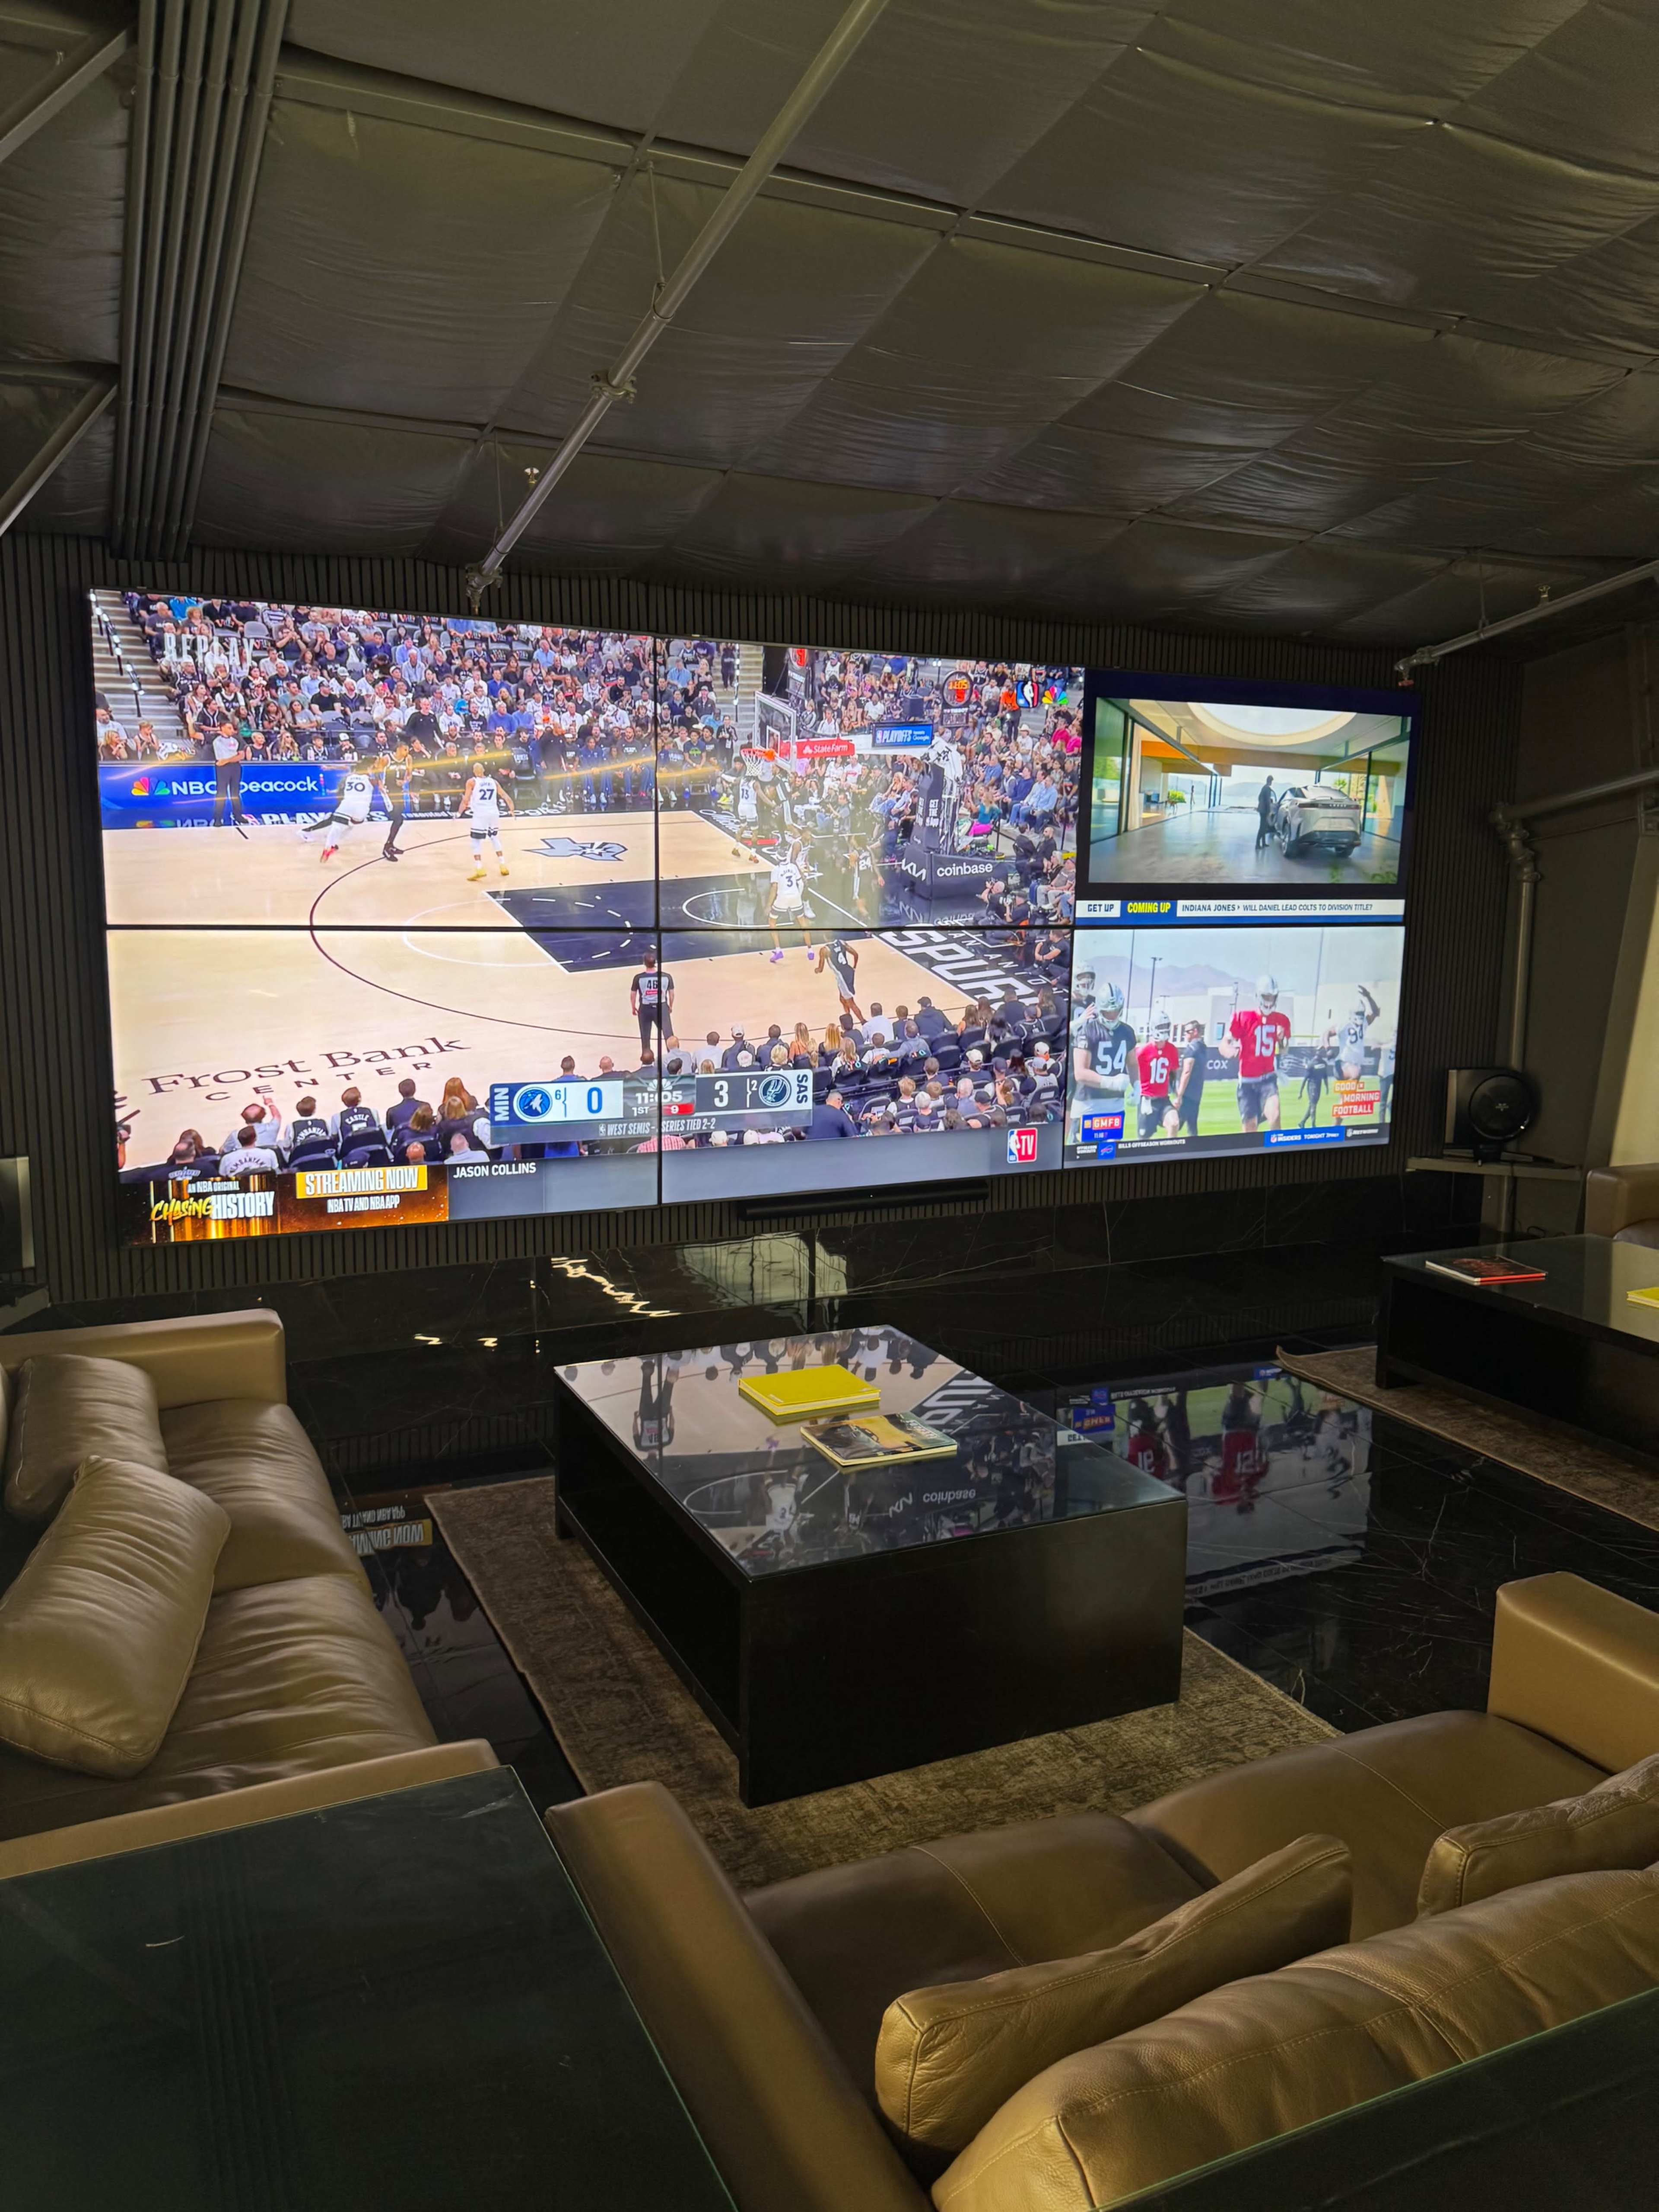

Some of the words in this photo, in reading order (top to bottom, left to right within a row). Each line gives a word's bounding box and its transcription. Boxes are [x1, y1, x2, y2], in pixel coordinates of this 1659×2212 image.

[882, 729, 912, 743] PLAYOFFS
[172, 780, 216, 795] NBC
[346, 782, 365, 792] 30
[479, 789, 494, 800] 27
[937, 862, 993, 877] coinbase
[785, 875, 794, 887] 3
[1087, 904, 1102, 912] GET
[1104, 904, 1114, 912] UP
[1127, 902, 1158, 913] COMING
[1160, 902, 1171, 913] UP
[1254, 1025, 1276, 1057] 15
[1095, 1040, 1127, 1076] 54
[1207, 1060, 1228, 1070] COX
[141, 1060, 312, 1095] Frost
[319, 1037, 471, 1069] Bank
[1150, 1057, 1169, 1084] 16
[205, 1063, 432, 1101] CENTER
[796, 1074, 808, 1104] SAS
[1335, 1082, 1356, 1091] GOOD
[635, 1090, 683, 1104] 11:05
[714, 1080, 729, 1108] 3
[751, 1080, 758, 1091] 2
[1343, 1092, 1380, 1102] MORNING
[494, 1087, 509, 1121] MIN
[555, 1089, 561, 1100] 6
[587, 1087, 603, 1114] 0
[632, 1106, 650, 1117] 1ST
[670, 1105, 680, 1114] 9
[1333, 1104, 1373, 1115] FOOTBALL
[345, 1114, 369, 1124] CASTLE
[607, 1124, 628, 1136] WEST
[628, 1122, 651, 1135] SEMIS
[657, 1120, 685, 1133] SERIES
[686, 1118, 701, 1131] TIED
[702, 1117, 716, 1130] 2-2
[1020, 1134, 1035, 1156] TV
[453, 1165, 489, 1178] JASON
[492, 1162, 537, 1176] COLLINS
[188, 1183, 197, 1194] AN
[197, 1181, 213, 1193] NBA
[213, 1181, 240, 1192] ORIGINAL
[305, 1169, 384, 1196] STREAMING
[386, 1167, 419, 1190] NOW
[210, 1191, 275, 1220] HISTORY
[327, 1199, 344, 1213] NBA
[343, 1198, 354, 1212] TV
[354, 1197, 369, 1211] AND
[369, 1195, 386, 1210] NBA
[385, 1194, 400, 1209] APP
